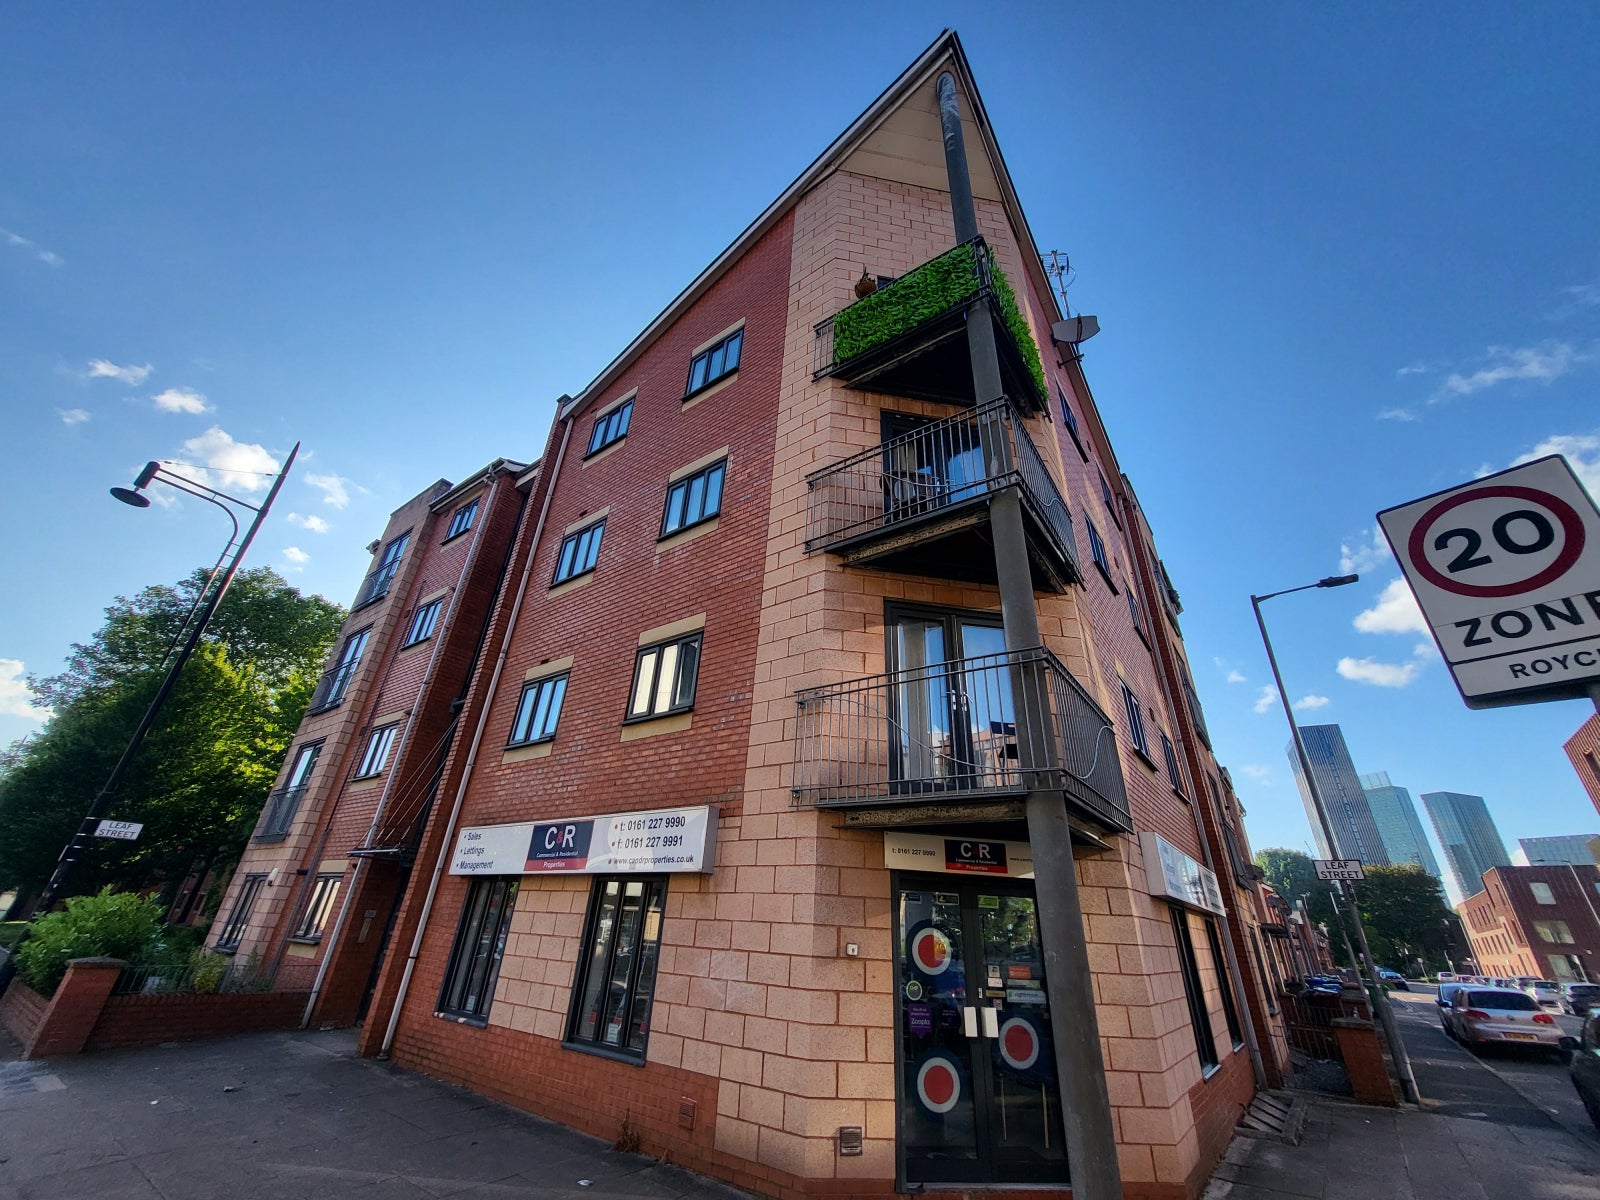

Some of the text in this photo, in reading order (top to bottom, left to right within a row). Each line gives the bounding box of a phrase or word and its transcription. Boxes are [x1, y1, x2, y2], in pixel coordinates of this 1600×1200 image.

[1434, 509, 1555, 574] 20
[1508, 649, 1600, 679] ROYC
[109, 821, 134, 830] LEAF
[627, 820, 646, 831] 0161
[647, 818, 663, 830] 227
[665, 816, 686, 828] 9990
[98, 829, 137, 839] STREET
[467, 832, 482, 841] Sales
[544, 824, 576, 850] C&R
[624, 837, 643, 849] 0161
[645, 836, 661, 848] 227
[662, 835, 683, 847] 9991
[463, 846, 485, 856] Lettings
[543, 860, 566, 869] Properties
[613, 854, 694, 865] www.candrproperties.co.uk
[460, 861, 494, 871] Management
[1324, 861, 1350, 870] LEAF
[1320, 870, 1360, 879] STREET
